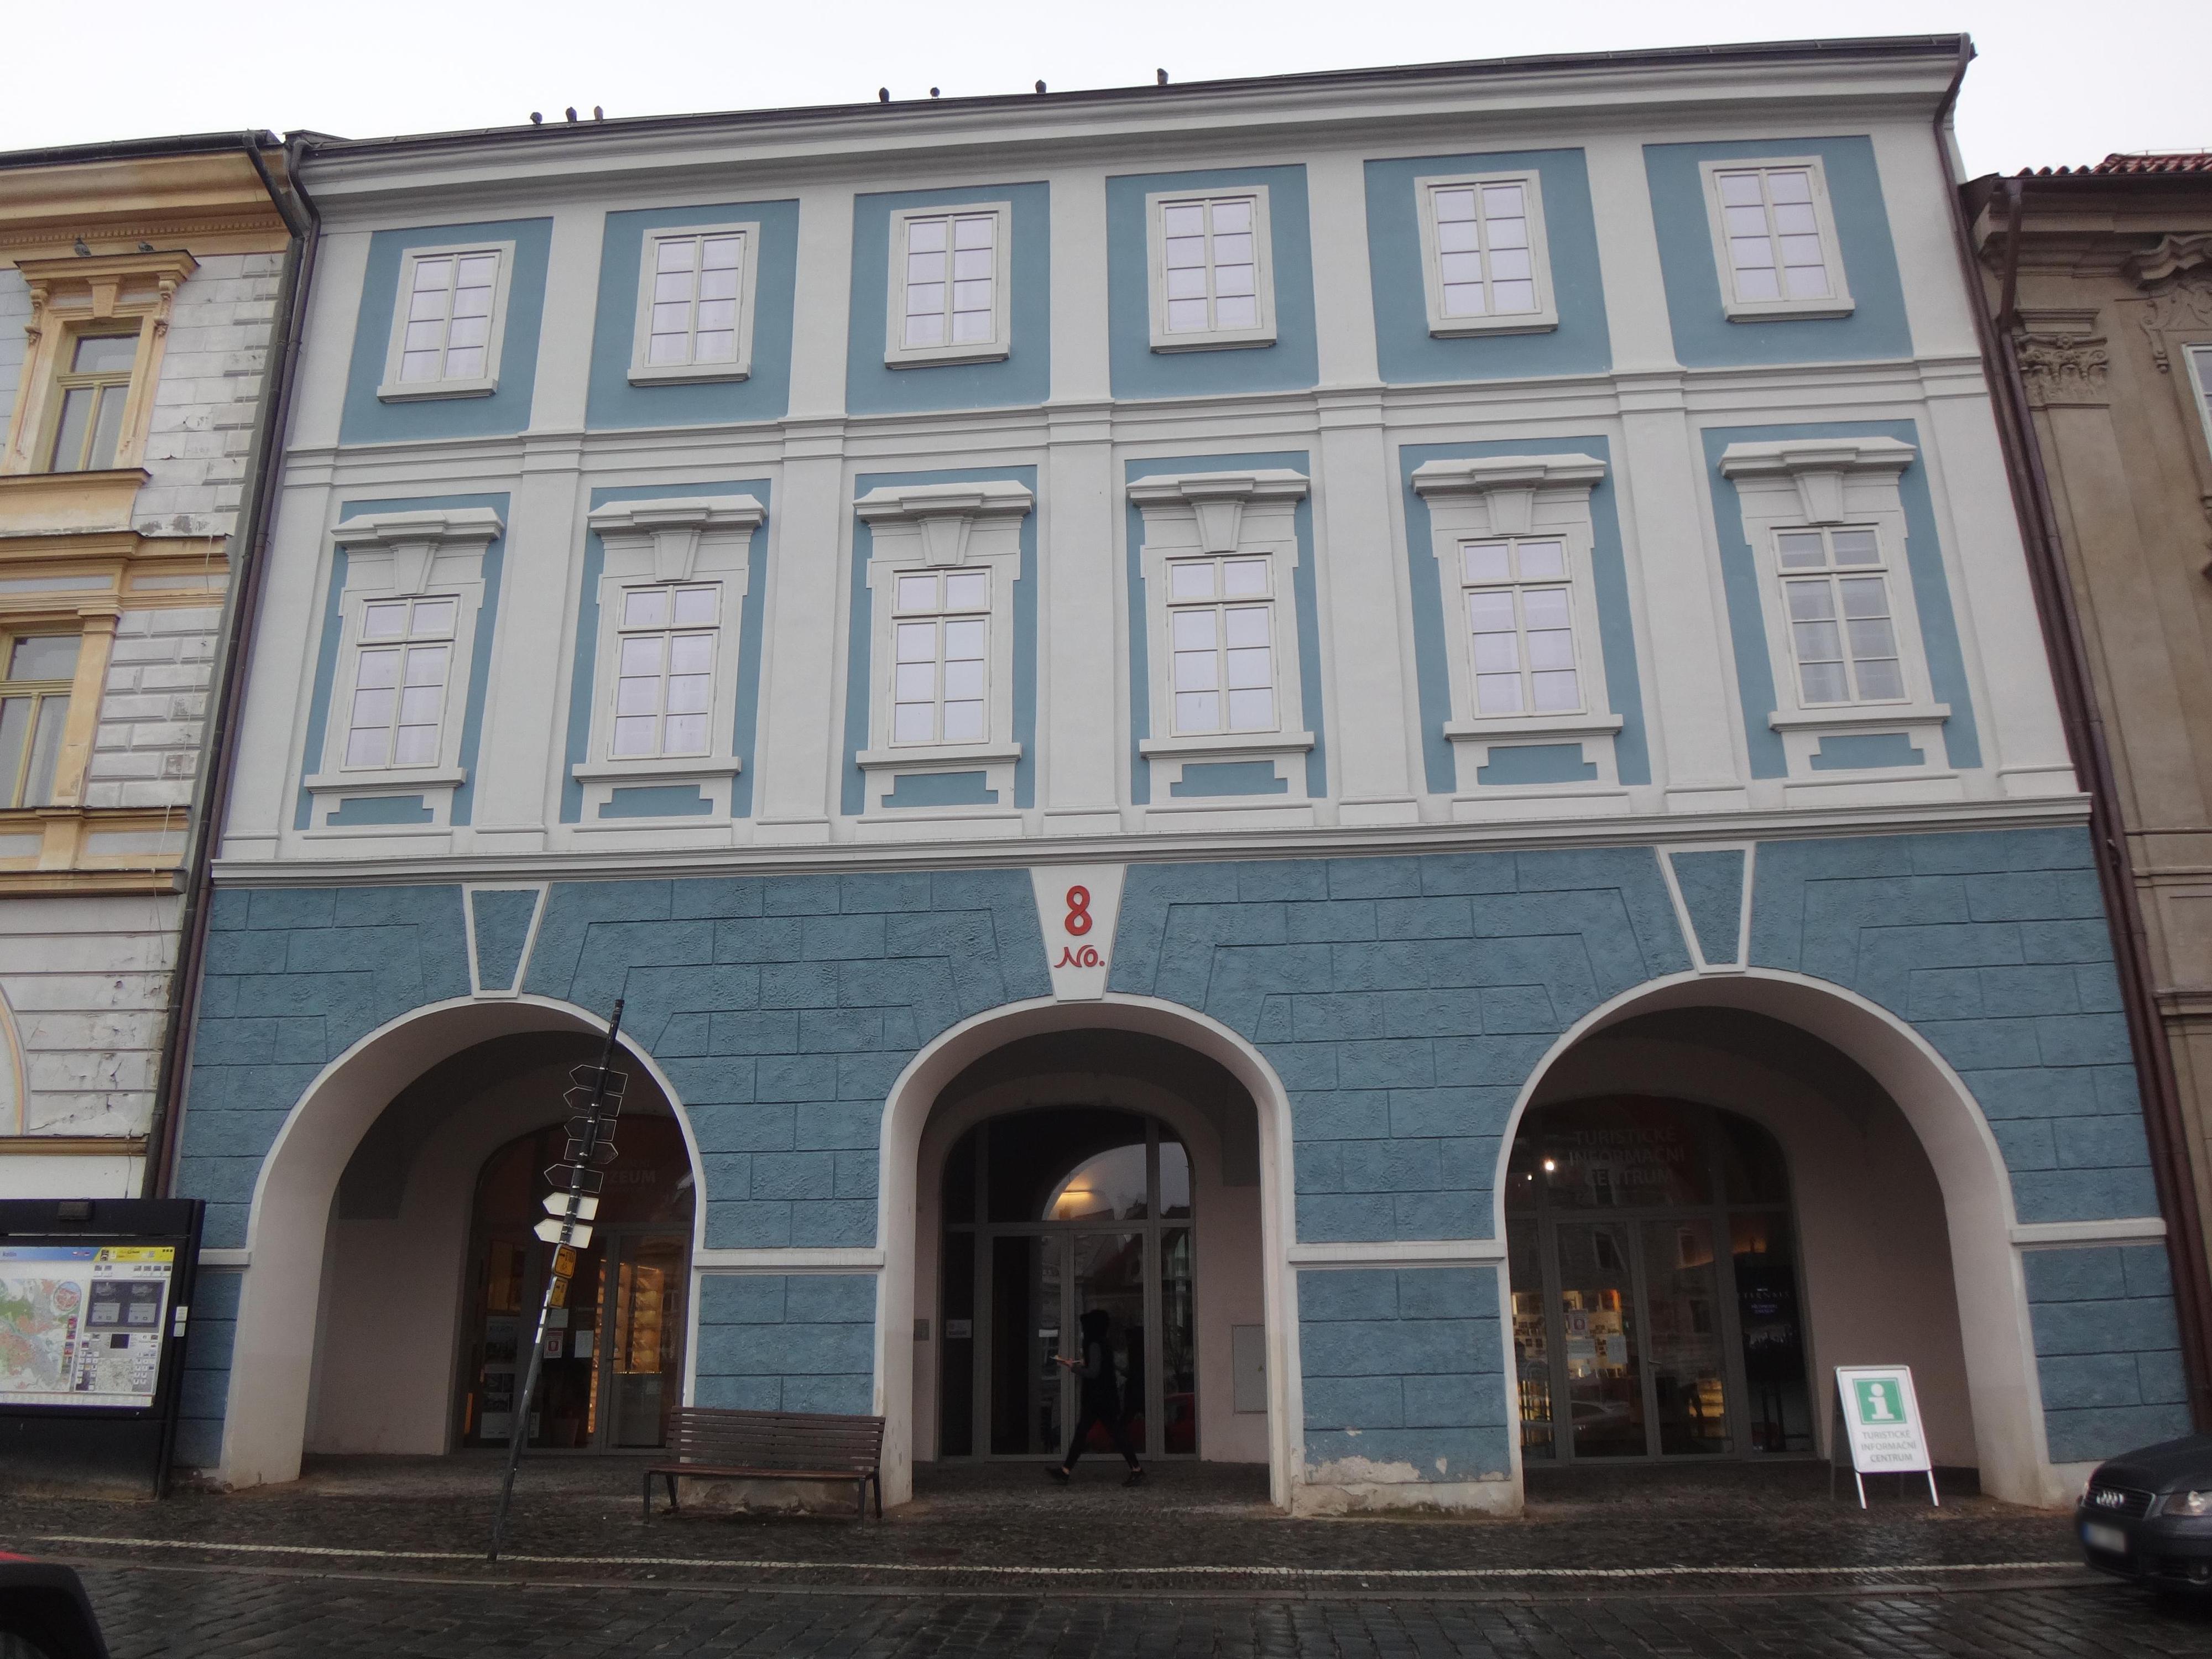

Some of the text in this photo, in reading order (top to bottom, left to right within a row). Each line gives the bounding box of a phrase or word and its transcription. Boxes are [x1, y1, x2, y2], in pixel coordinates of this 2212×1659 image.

[1065, 885, 1093, 936] 8
[1053, 944, 1105, 968] No.
[1863, 1430, 1911, 1439] TURISTICKÉ
[1861, 1441, 1917, 1451] INFORMAČNÍ
[1870, 1453, 1913, 1463] CENTRUM
